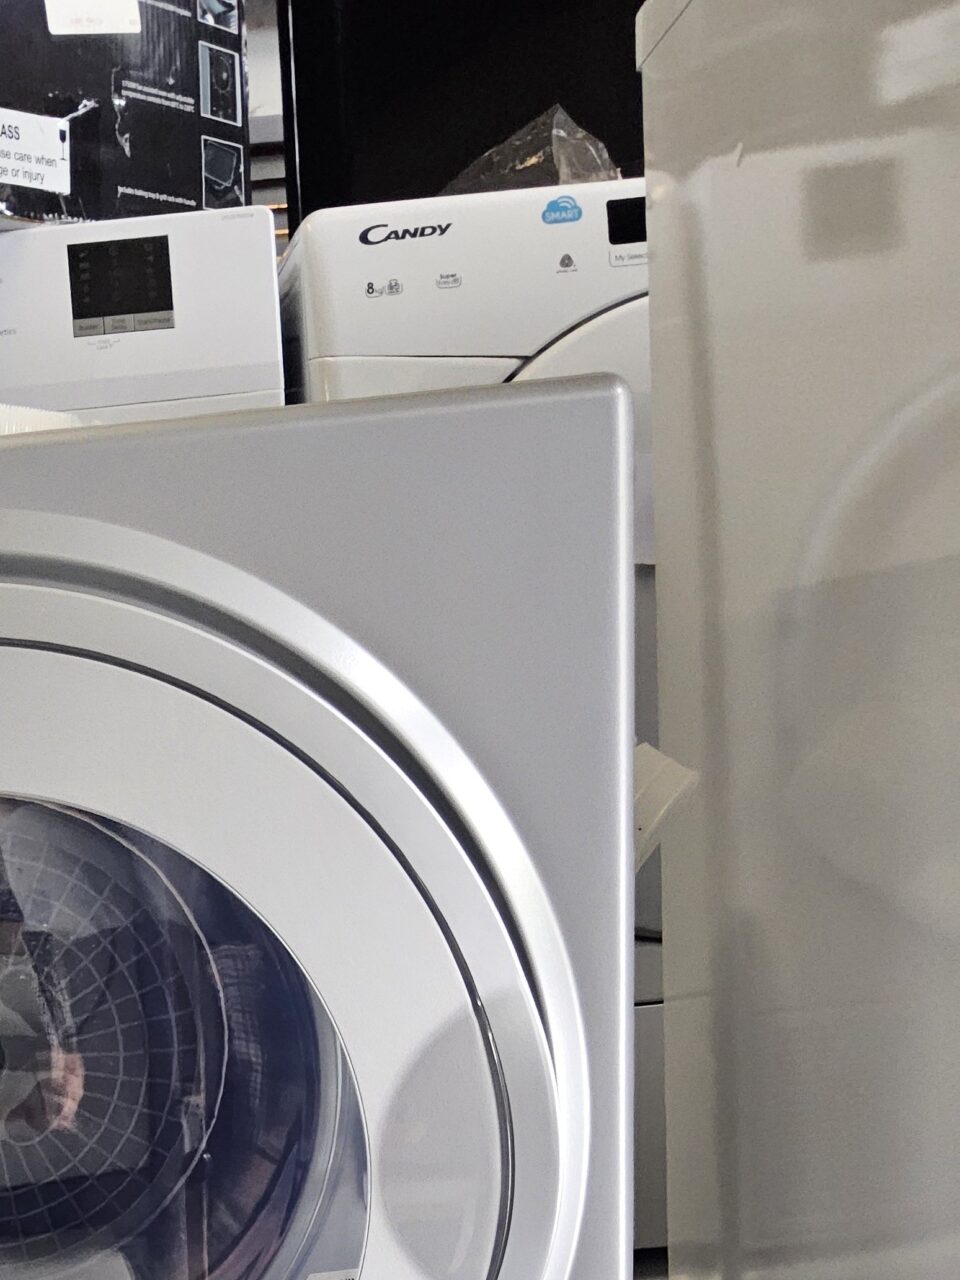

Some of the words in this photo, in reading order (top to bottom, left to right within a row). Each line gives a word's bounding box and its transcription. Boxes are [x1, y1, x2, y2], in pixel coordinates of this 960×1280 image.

[14, 151, 33, 164] care
[34, 154, 58, 169] when
[11, 167, 20, 178] or
[22, 168, 46, 185] injury
[545, 208, 580, 220] SMART
[358, 221, 453, 246] CANDY
